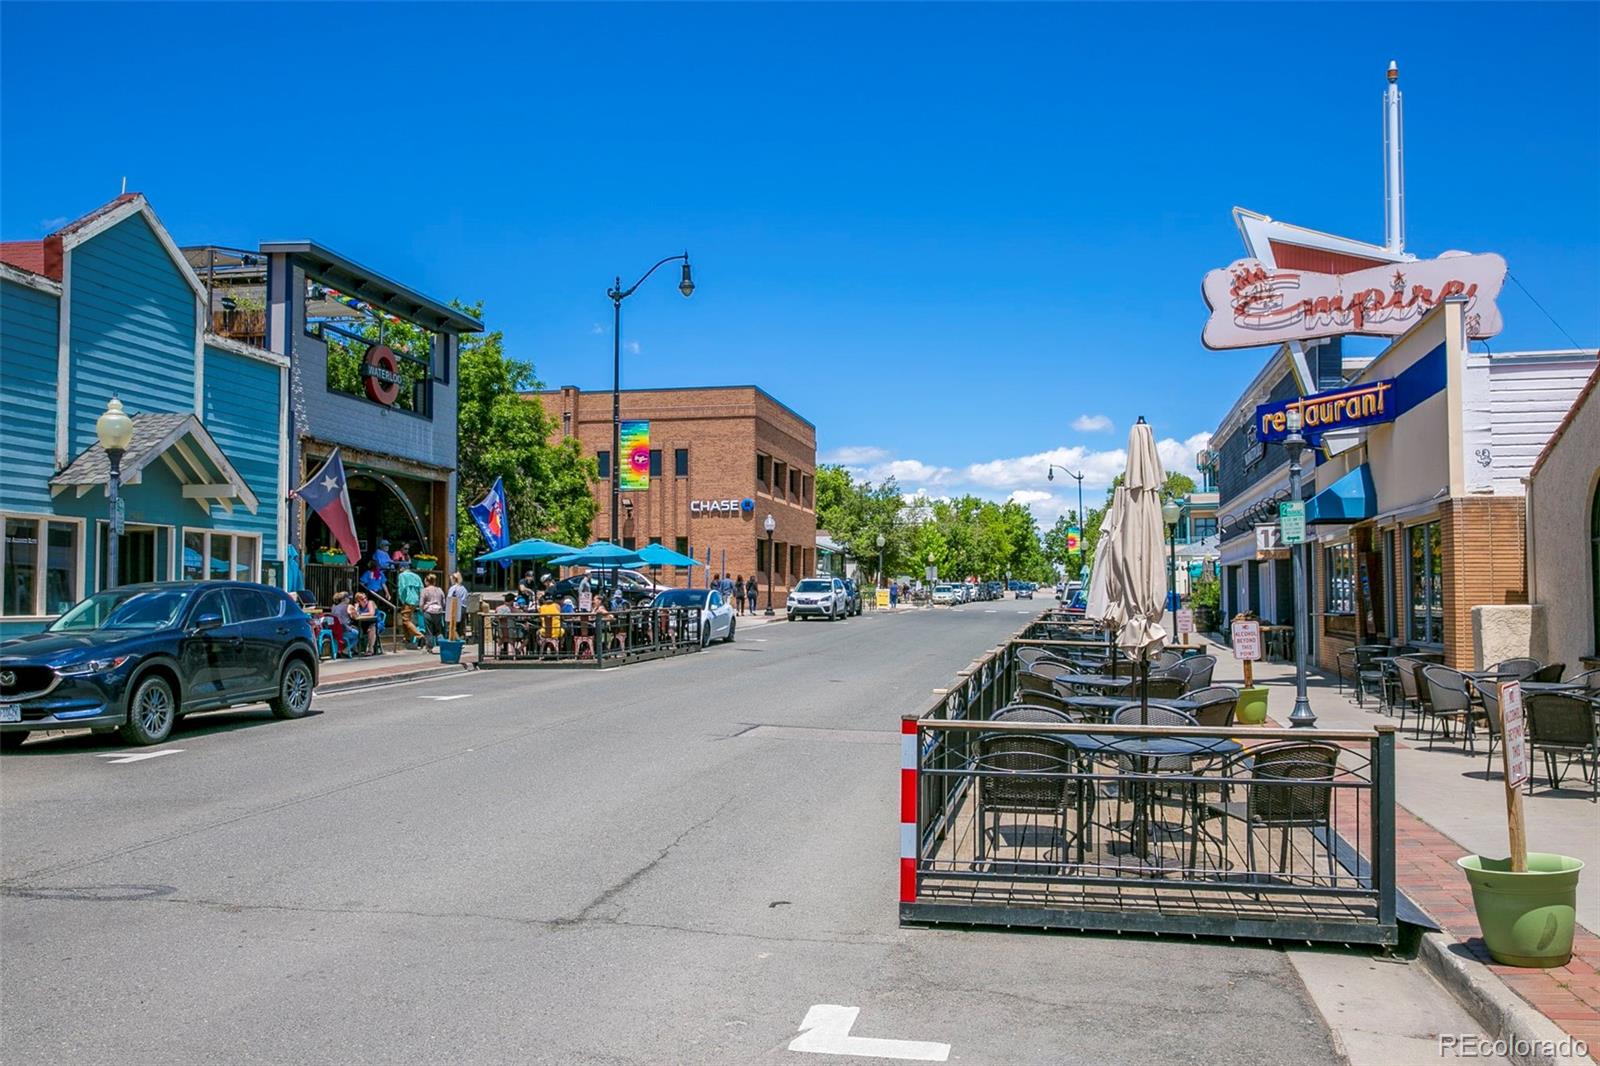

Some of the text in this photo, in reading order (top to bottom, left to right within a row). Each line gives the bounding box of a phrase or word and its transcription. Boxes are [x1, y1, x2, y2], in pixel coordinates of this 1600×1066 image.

[367, 364, 402, 384] WATERLOO
[1262, 382, 1391, 434] retaurant
[690, 500, 739, 512] CHASE
